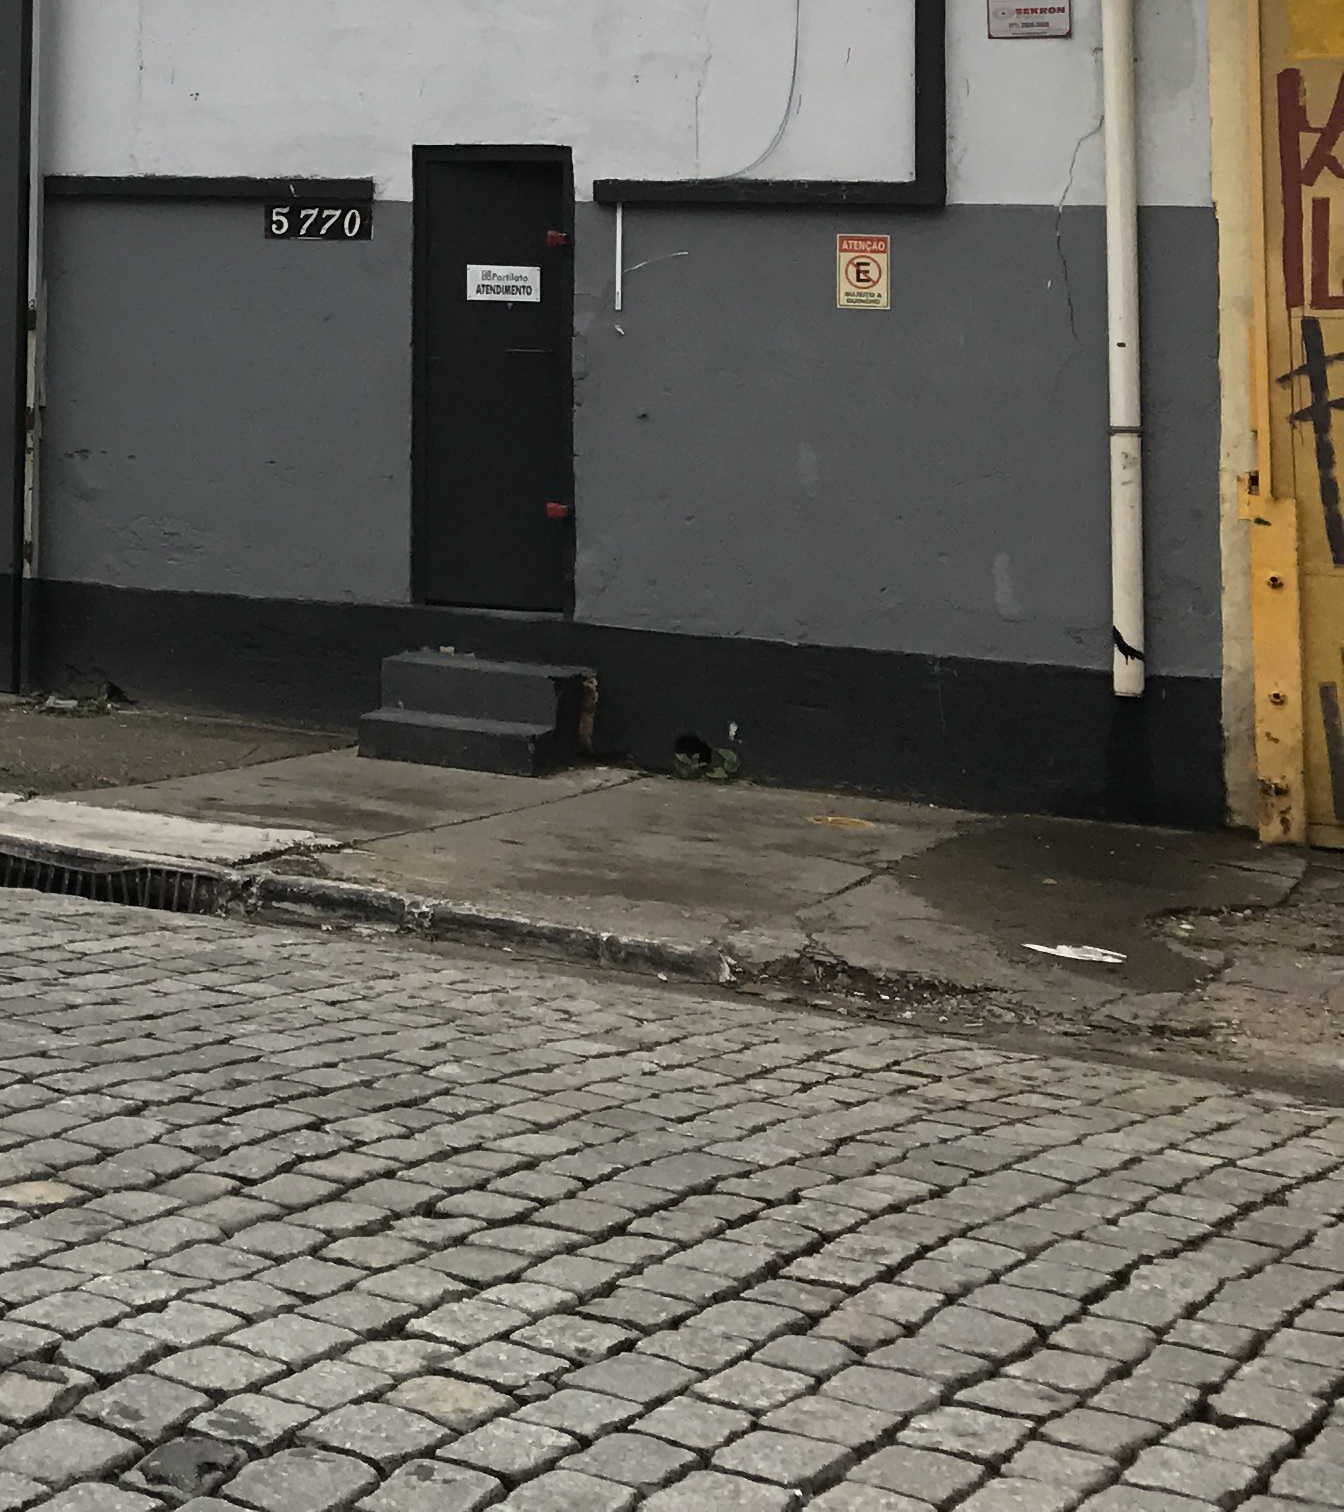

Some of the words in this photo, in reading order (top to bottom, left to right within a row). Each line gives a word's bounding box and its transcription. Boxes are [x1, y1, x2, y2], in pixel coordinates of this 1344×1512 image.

[1015, 7, 1065, 15] SEKRON
[271, 206, 361, 237] 5770
[842, 238, 885, 253] ATENÇÃO
[476, 284, 533, 296] ATENDIMENTO
